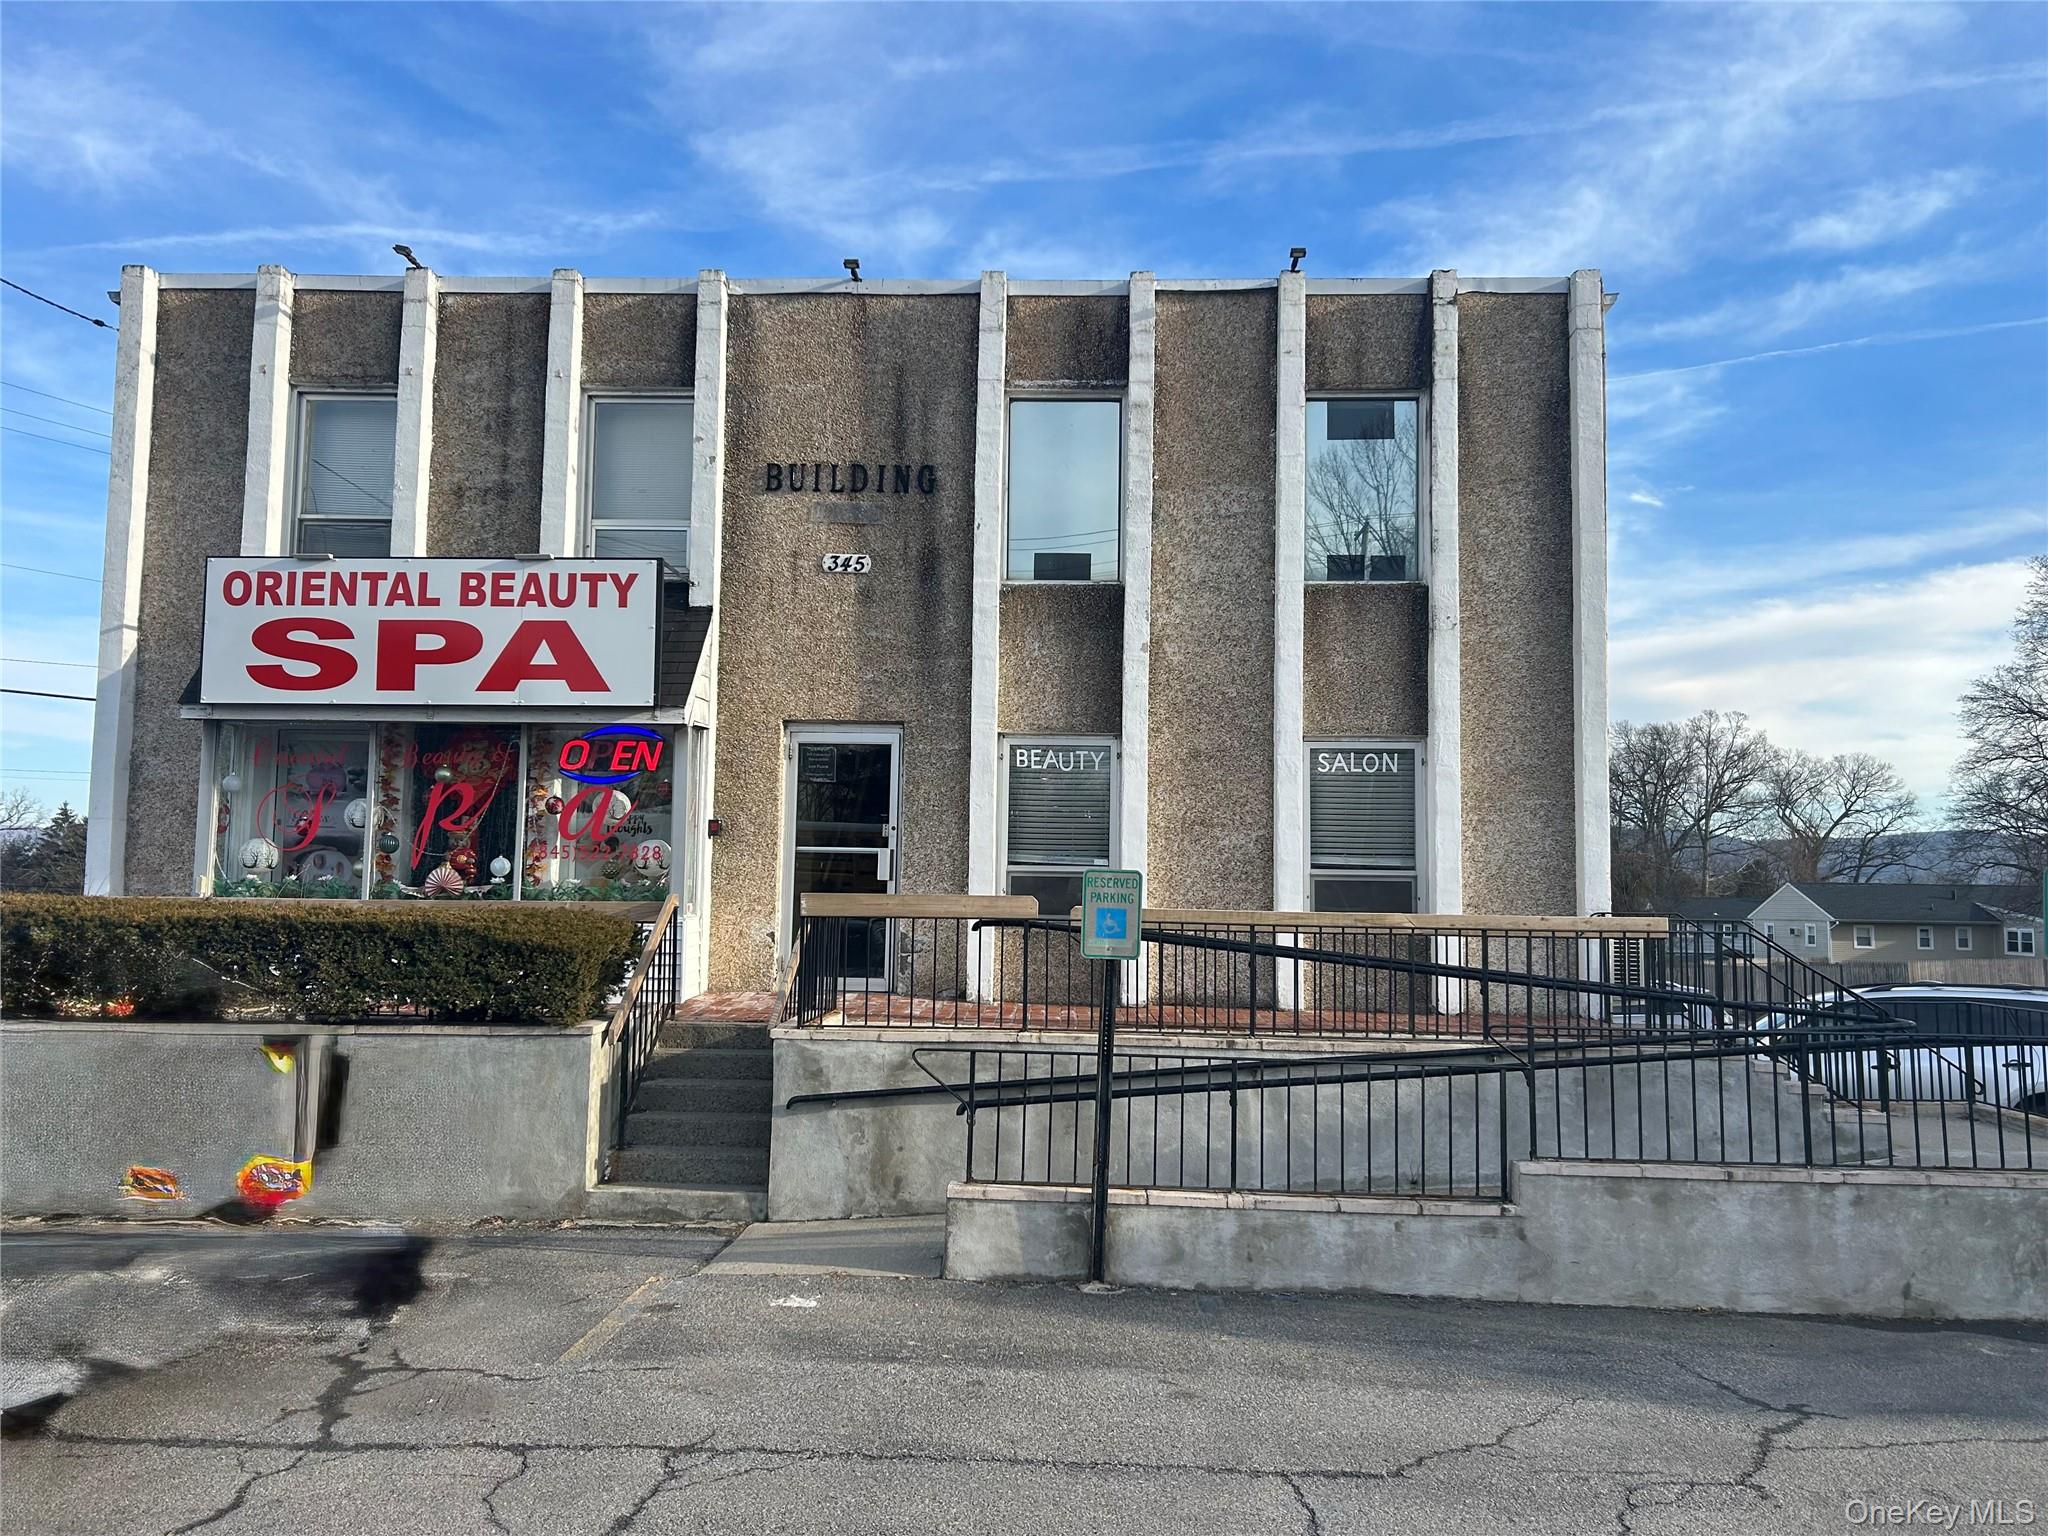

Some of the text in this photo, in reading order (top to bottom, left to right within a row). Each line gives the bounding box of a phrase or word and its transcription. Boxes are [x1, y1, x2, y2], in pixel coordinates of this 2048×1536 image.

[765, 462, 937, 494] BUILDING
[827, 555, 867, 572] 345
[222, 570, 640, 609] ORIENTAL BEAUTY
[245, 616, 612, 693] SPA
[559, 738, 664, 771] OPEN
[1016, 748, 1105, 772] BEAUTY
[1317, 752, 1398, 773] SALON
[1087, 876, 1138, 889] RESERVED
[1090, 891, 1134, 904] PARKING
